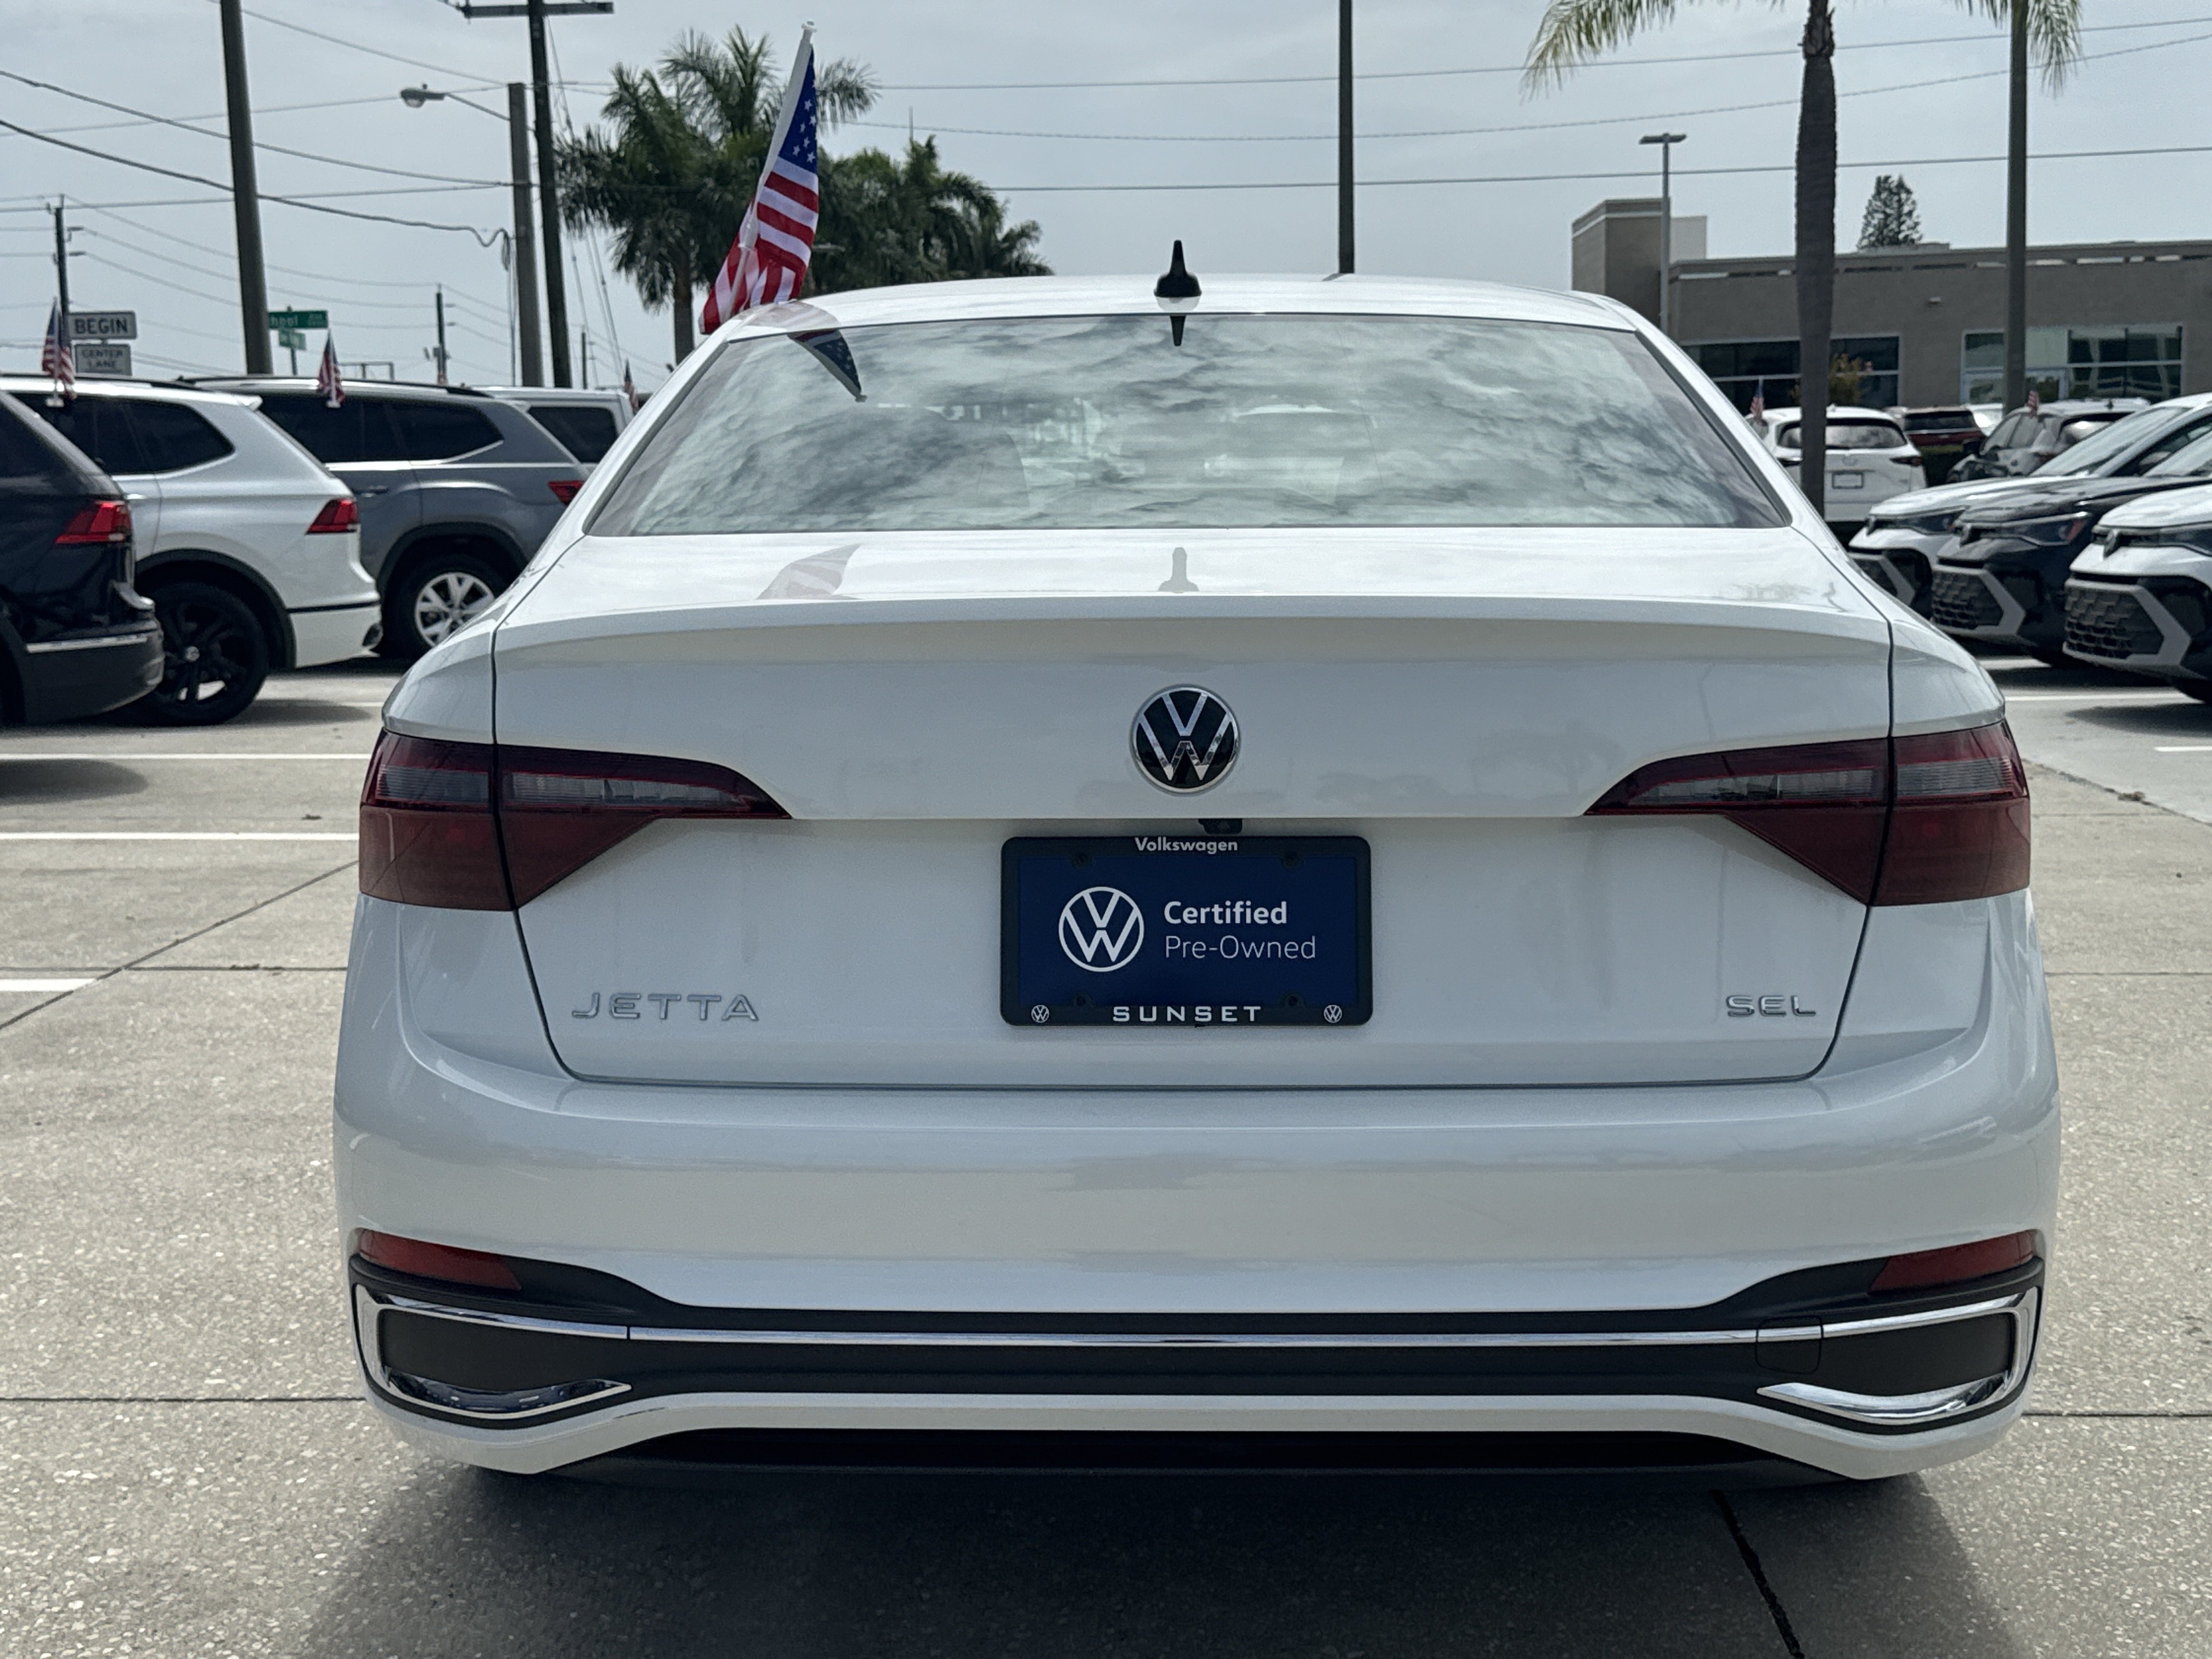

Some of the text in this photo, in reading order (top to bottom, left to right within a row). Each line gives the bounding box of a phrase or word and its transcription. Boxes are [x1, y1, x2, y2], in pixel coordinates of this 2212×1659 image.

[75, 318, 128, 334] BEGIN
[1135, 837, 1238, 854] Volkswagen
[1164, 901, 1287, 924] Certified
[1059, 887, 1144, 972] VW
[1166, 935, 1316, 959] Pre-Owned
[572, 992, 759, 1021] JETTA
[1113, 1006, 1261, 1022] SUNSET
[1726, 995, 1816, 1017] SEL
